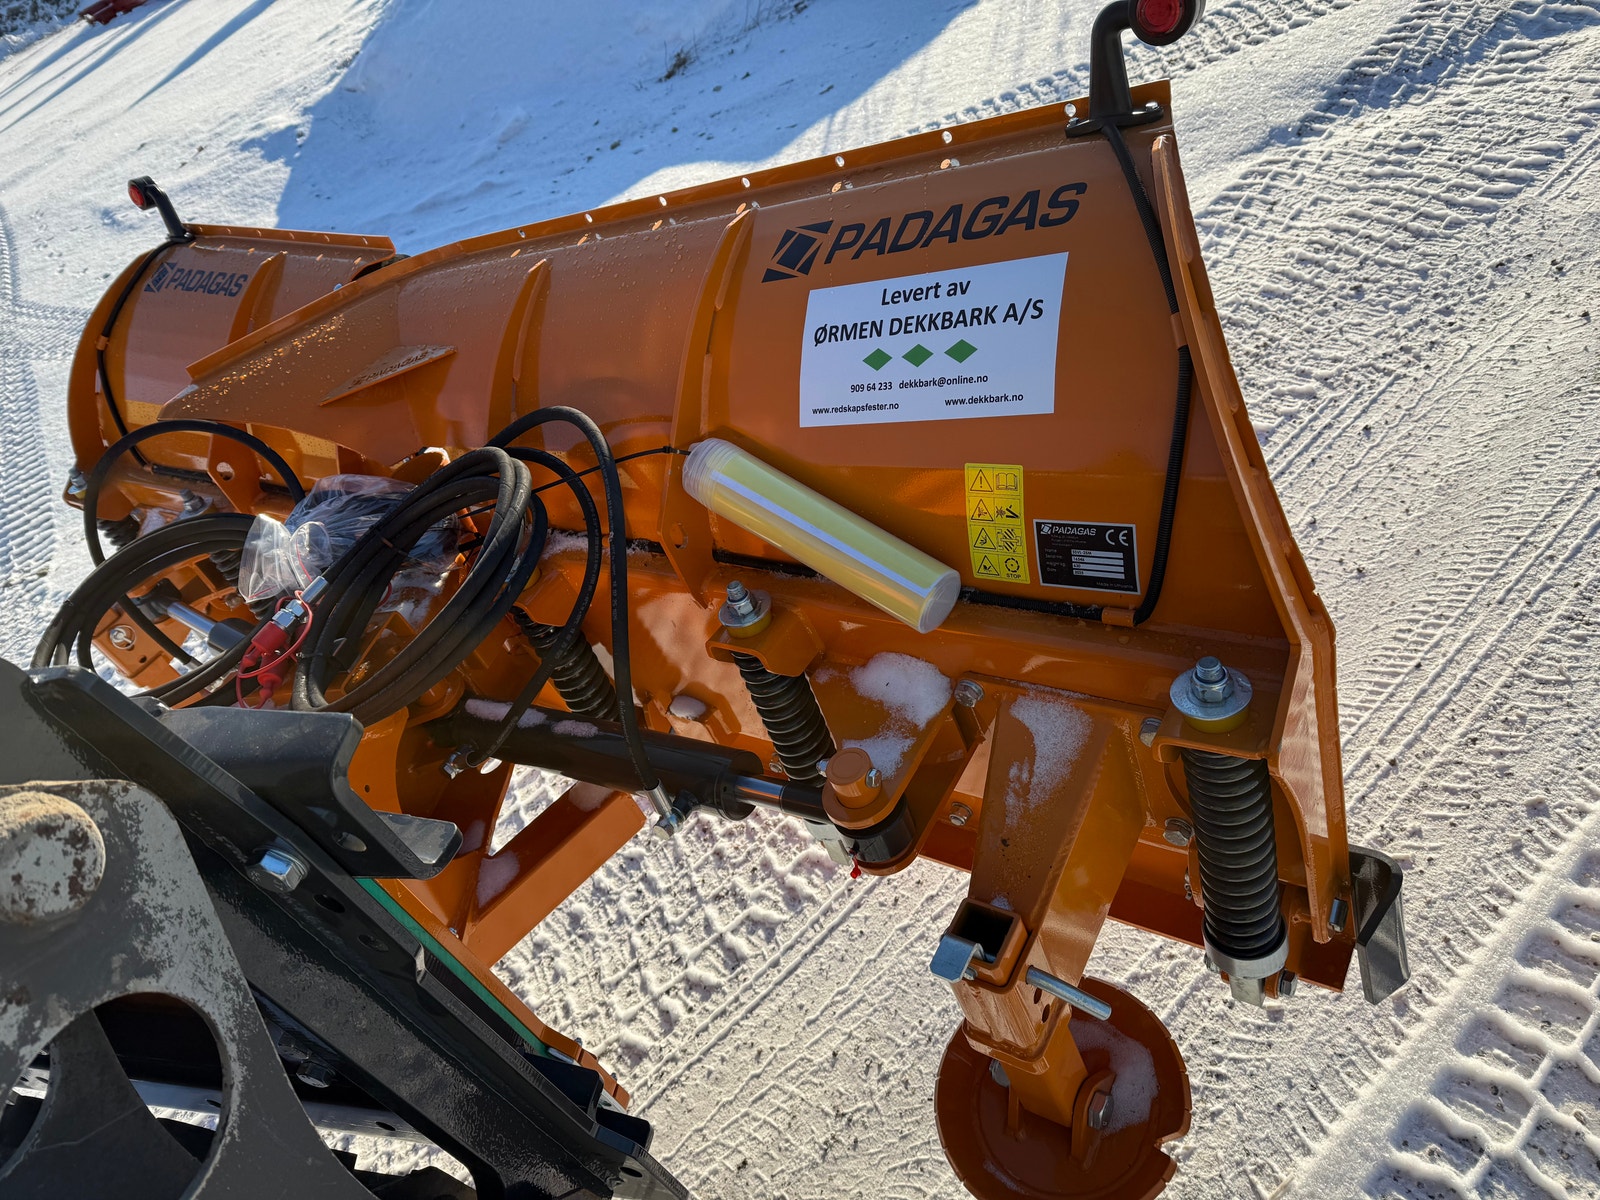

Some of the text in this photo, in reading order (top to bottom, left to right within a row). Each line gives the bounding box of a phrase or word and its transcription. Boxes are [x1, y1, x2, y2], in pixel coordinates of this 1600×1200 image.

[823, 181, 1088, 265] PADAGAS
[164, 267, 249, 298] PADAGAS
[881, 280, 971, 306] Levert av
[813, 298, 1045, 347] ØRMEN DEKKBARK A/S
[850, 375, 989, 393] 909 64 233 dekkbark@online.no
[811, 402, 900, 415] www.redskapsfester.no
[944, 393, 1024, 406] www.dekkbark.no
[1052, 526, 1097, 536] PADAGAS
